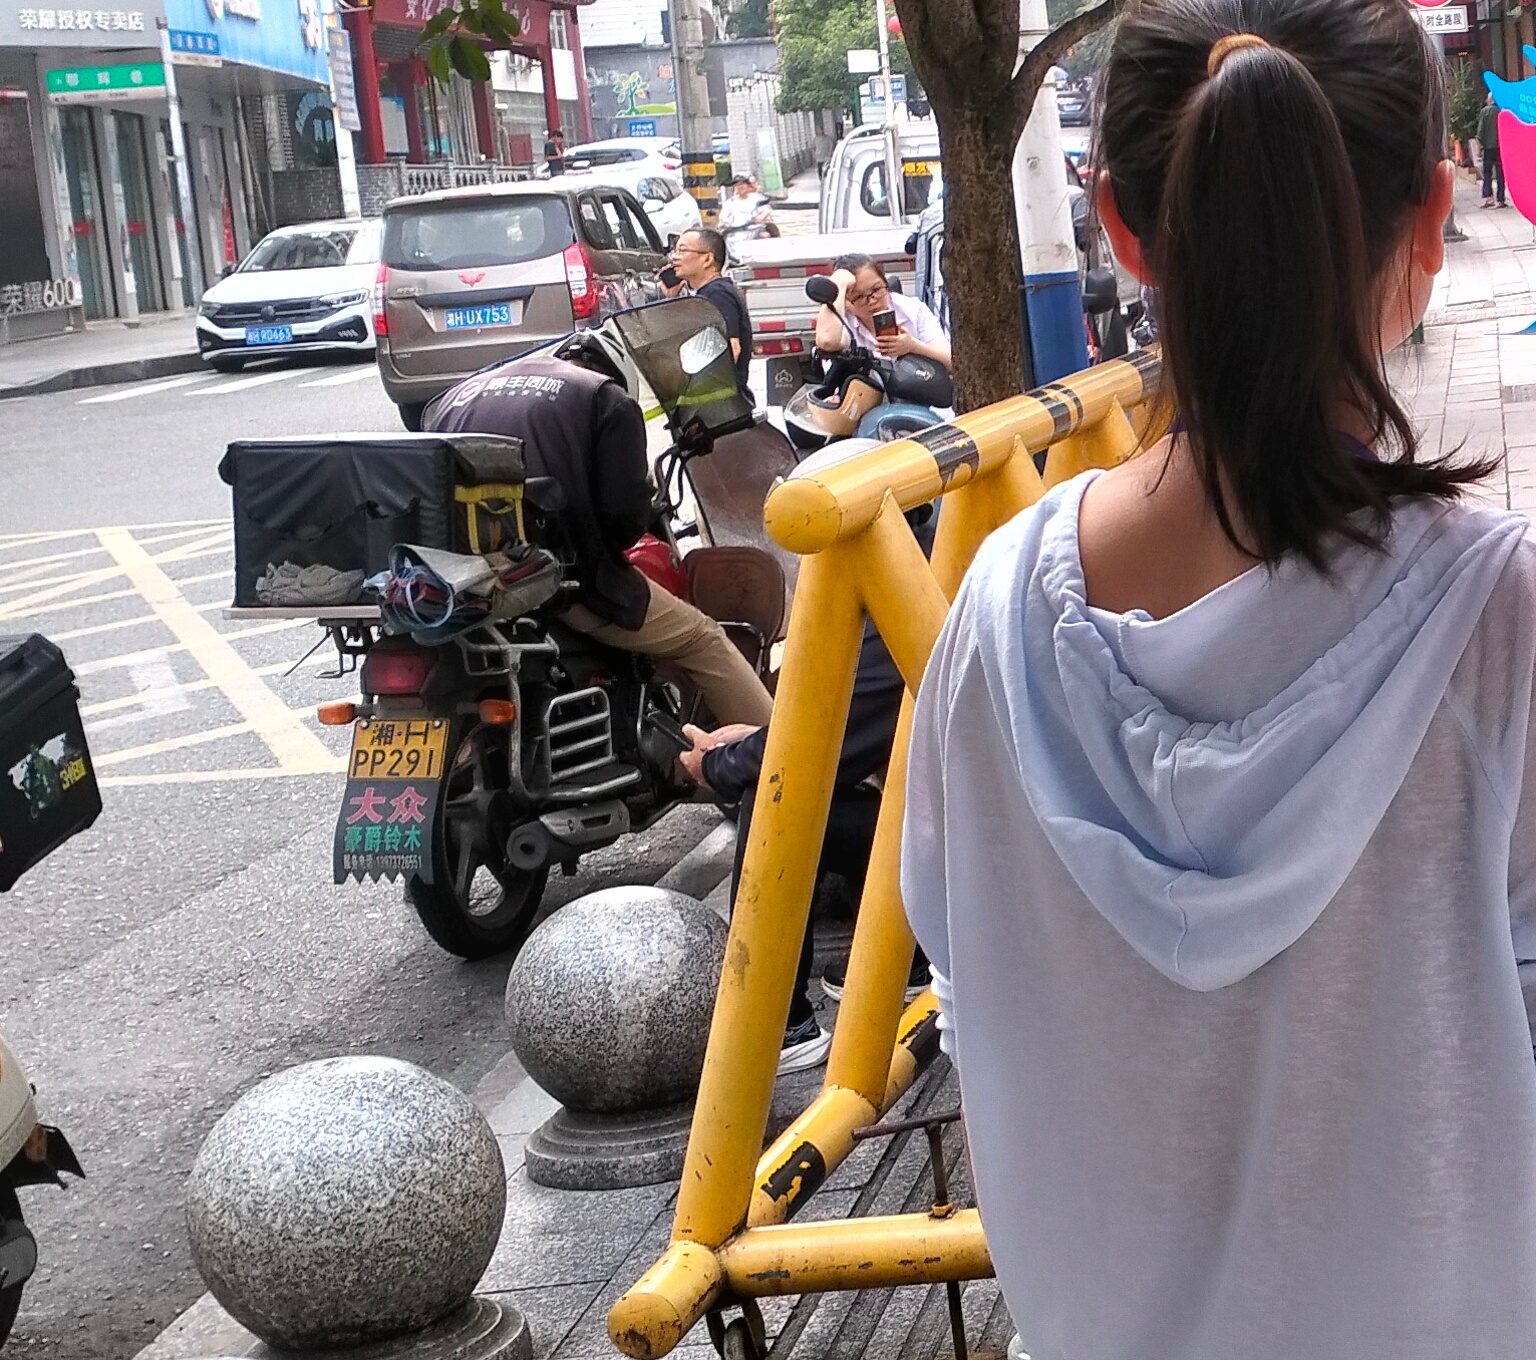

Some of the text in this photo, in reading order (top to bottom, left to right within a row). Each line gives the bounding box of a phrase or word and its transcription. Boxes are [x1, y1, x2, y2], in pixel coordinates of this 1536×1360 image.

[19, 9, 145, 31] 荣耀授权专卖店
[3, 278, 75, 313] 荣耀600
[485, 376, 565, 394] 顺丰同城
[352, 749, 434, 777] PP291
[347, 787, 428, 824] 大众
[344, 825, 422, 853] 豪爵铃木
